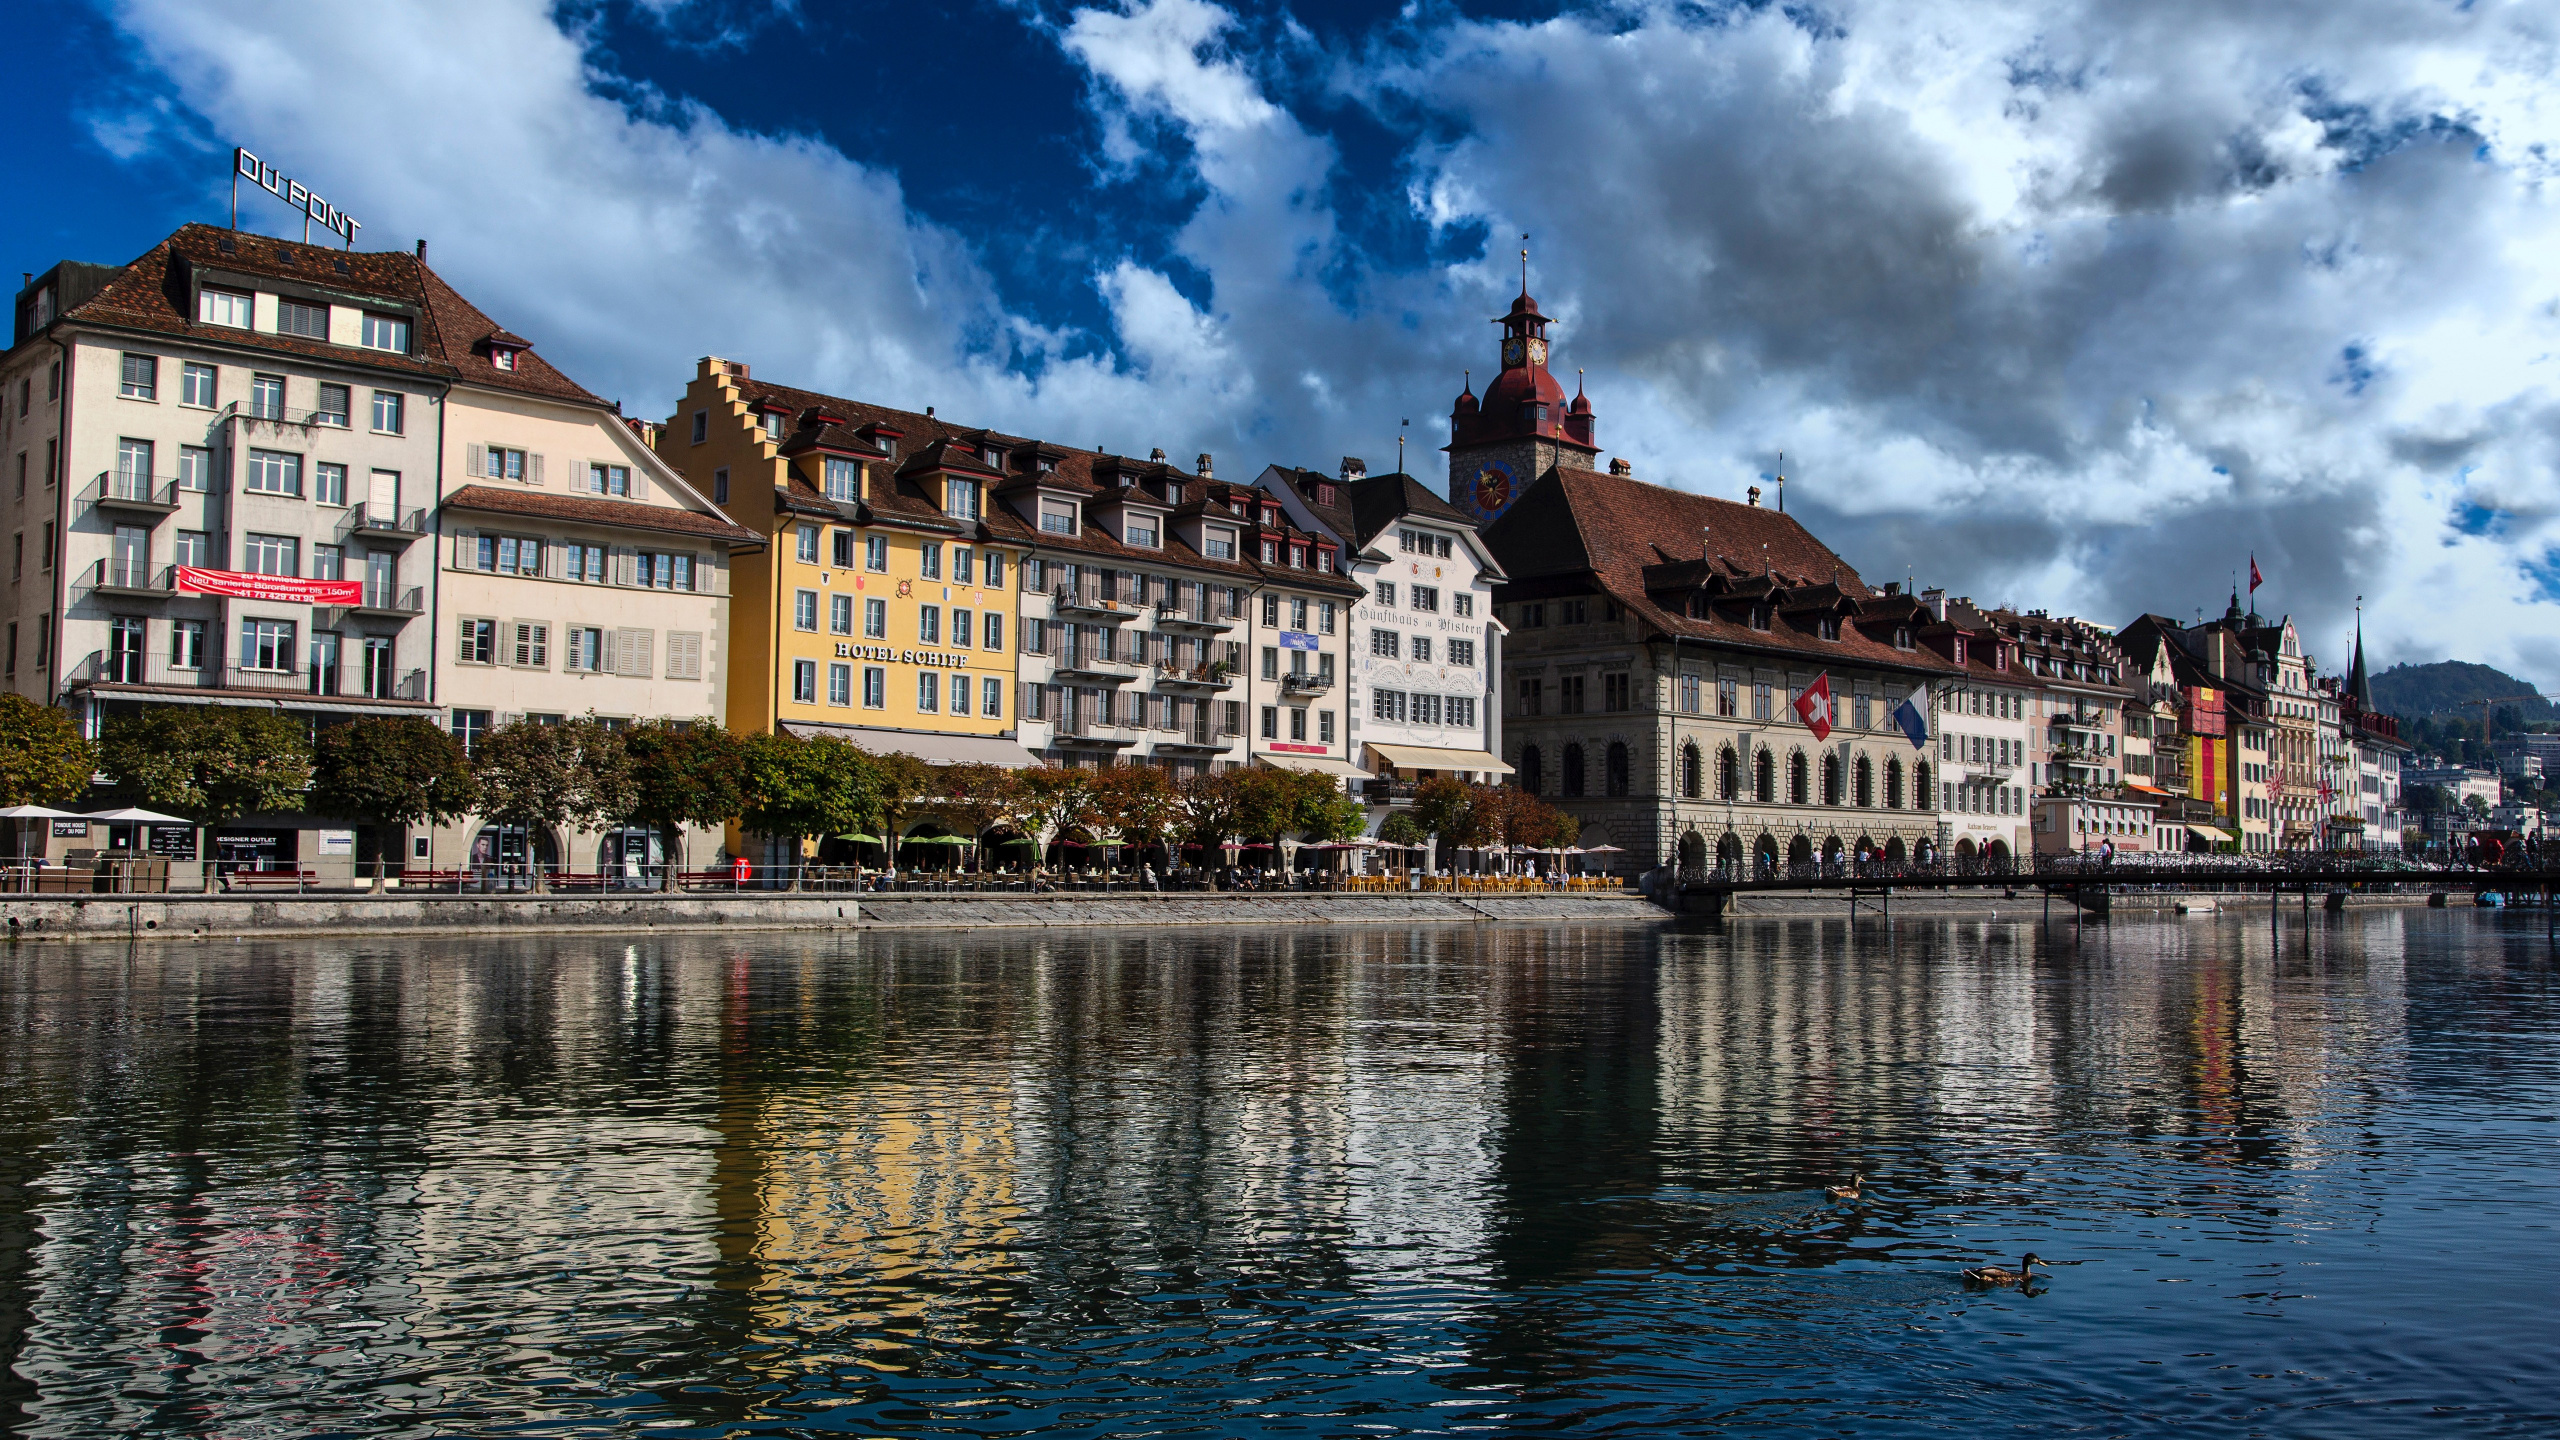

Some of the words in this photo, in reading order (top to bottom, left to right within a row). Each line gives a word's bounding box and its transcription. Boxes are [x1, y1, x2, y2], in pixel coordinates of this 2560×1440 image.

[239, 147, 279, 194] DU
[288, 179, 361, 243] PONT
[188, 575, 209, 584] Neu
[212, 579, 252, 588] sanierte
[254, 582, 306, 593] Büroräume
[309, 586, 323, 594] bis
[256, 574, 305, 584] vermieten
[234, 590, 251, 598] +41
[1438, 618, 1482, 635] Pfistern
[836, 642, 900, 661] HOTEL
[902, 649, 969, 668] SCHIFF
